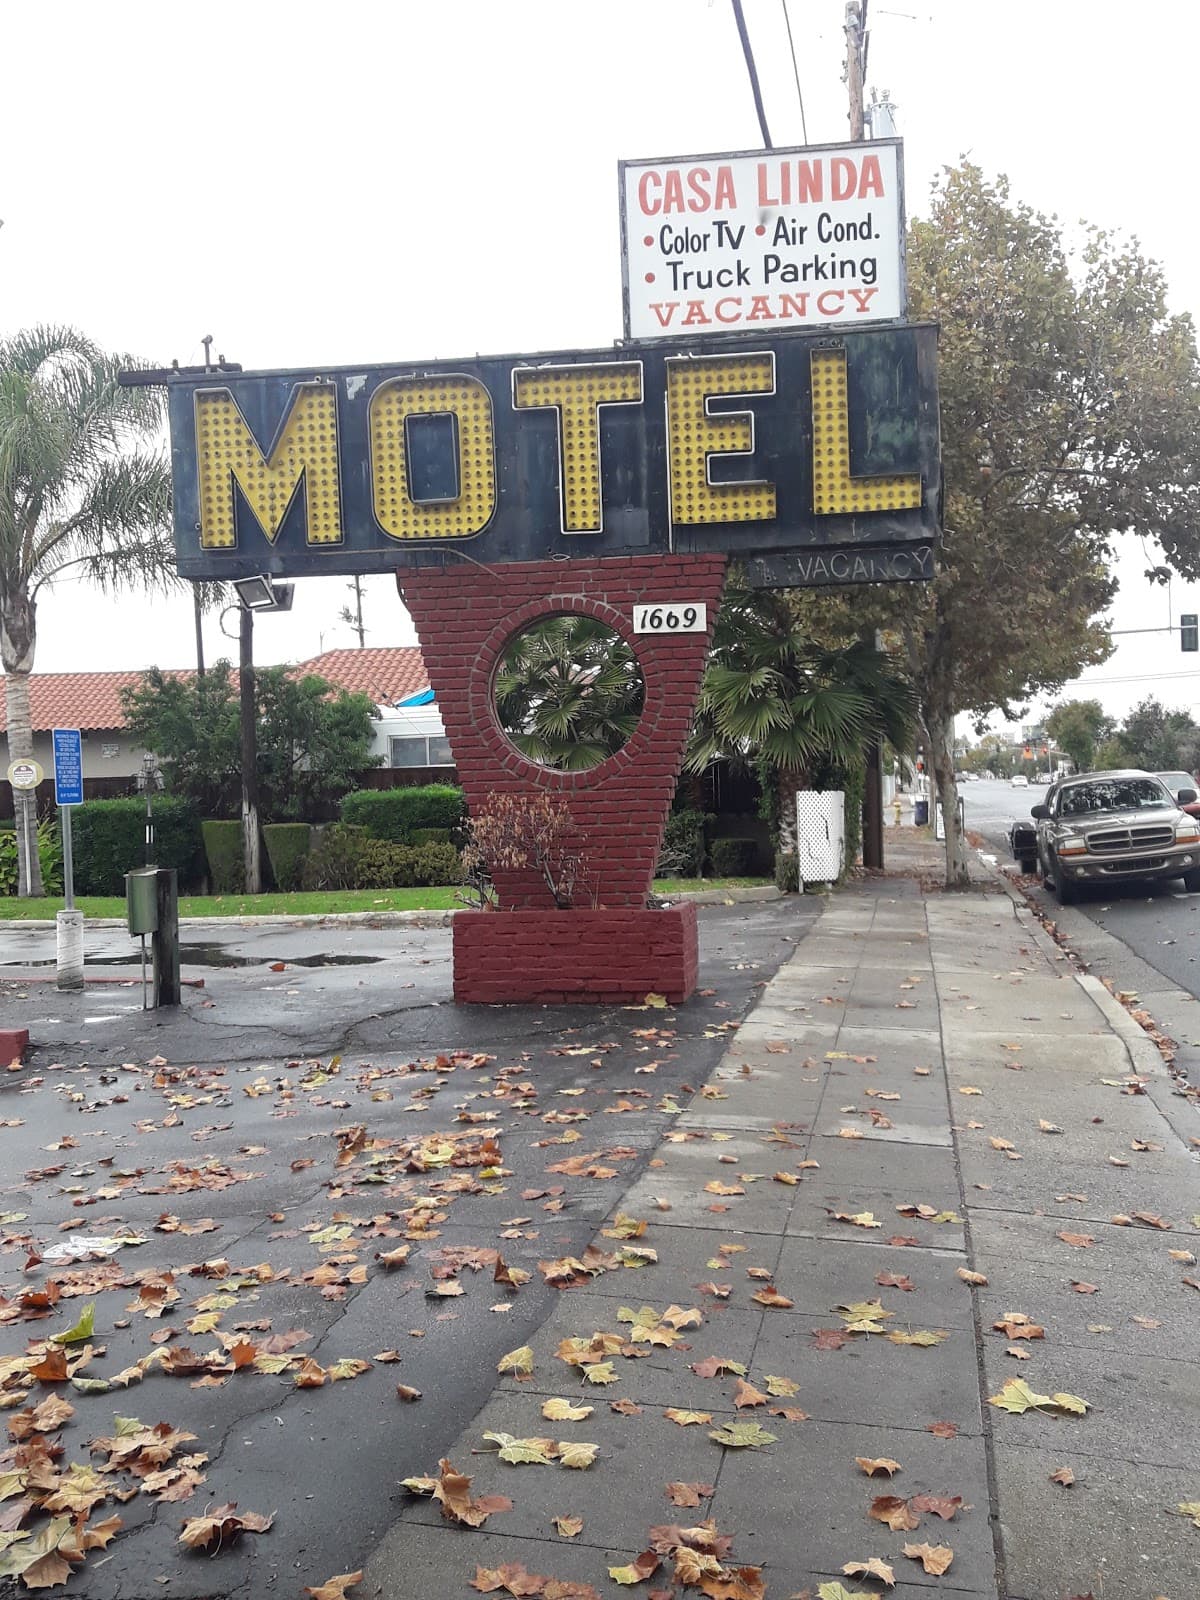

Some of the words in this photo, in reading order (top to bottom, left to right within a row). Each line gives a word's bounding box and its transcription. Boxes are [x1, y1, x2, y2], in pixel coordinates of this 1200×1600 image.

[638, 165, 738, 216] CASA
[757, 154, 885, 207] LINDA
[659, 224, 711, 256] Color
[712, 220, 746, 250] TV
[772, 215, 808, 247] Air
[817, 211, 881, 243] Cond.
[666, 259, 751, 291] Truck
[763, 252, 878, 285] Parking
[649, 287, 879, 328] VACANCY
[193, 347, 923, 549] MOTEL
[797, 546, 932, 580] VACANCY
[640, 607, 697, 630] 1669
